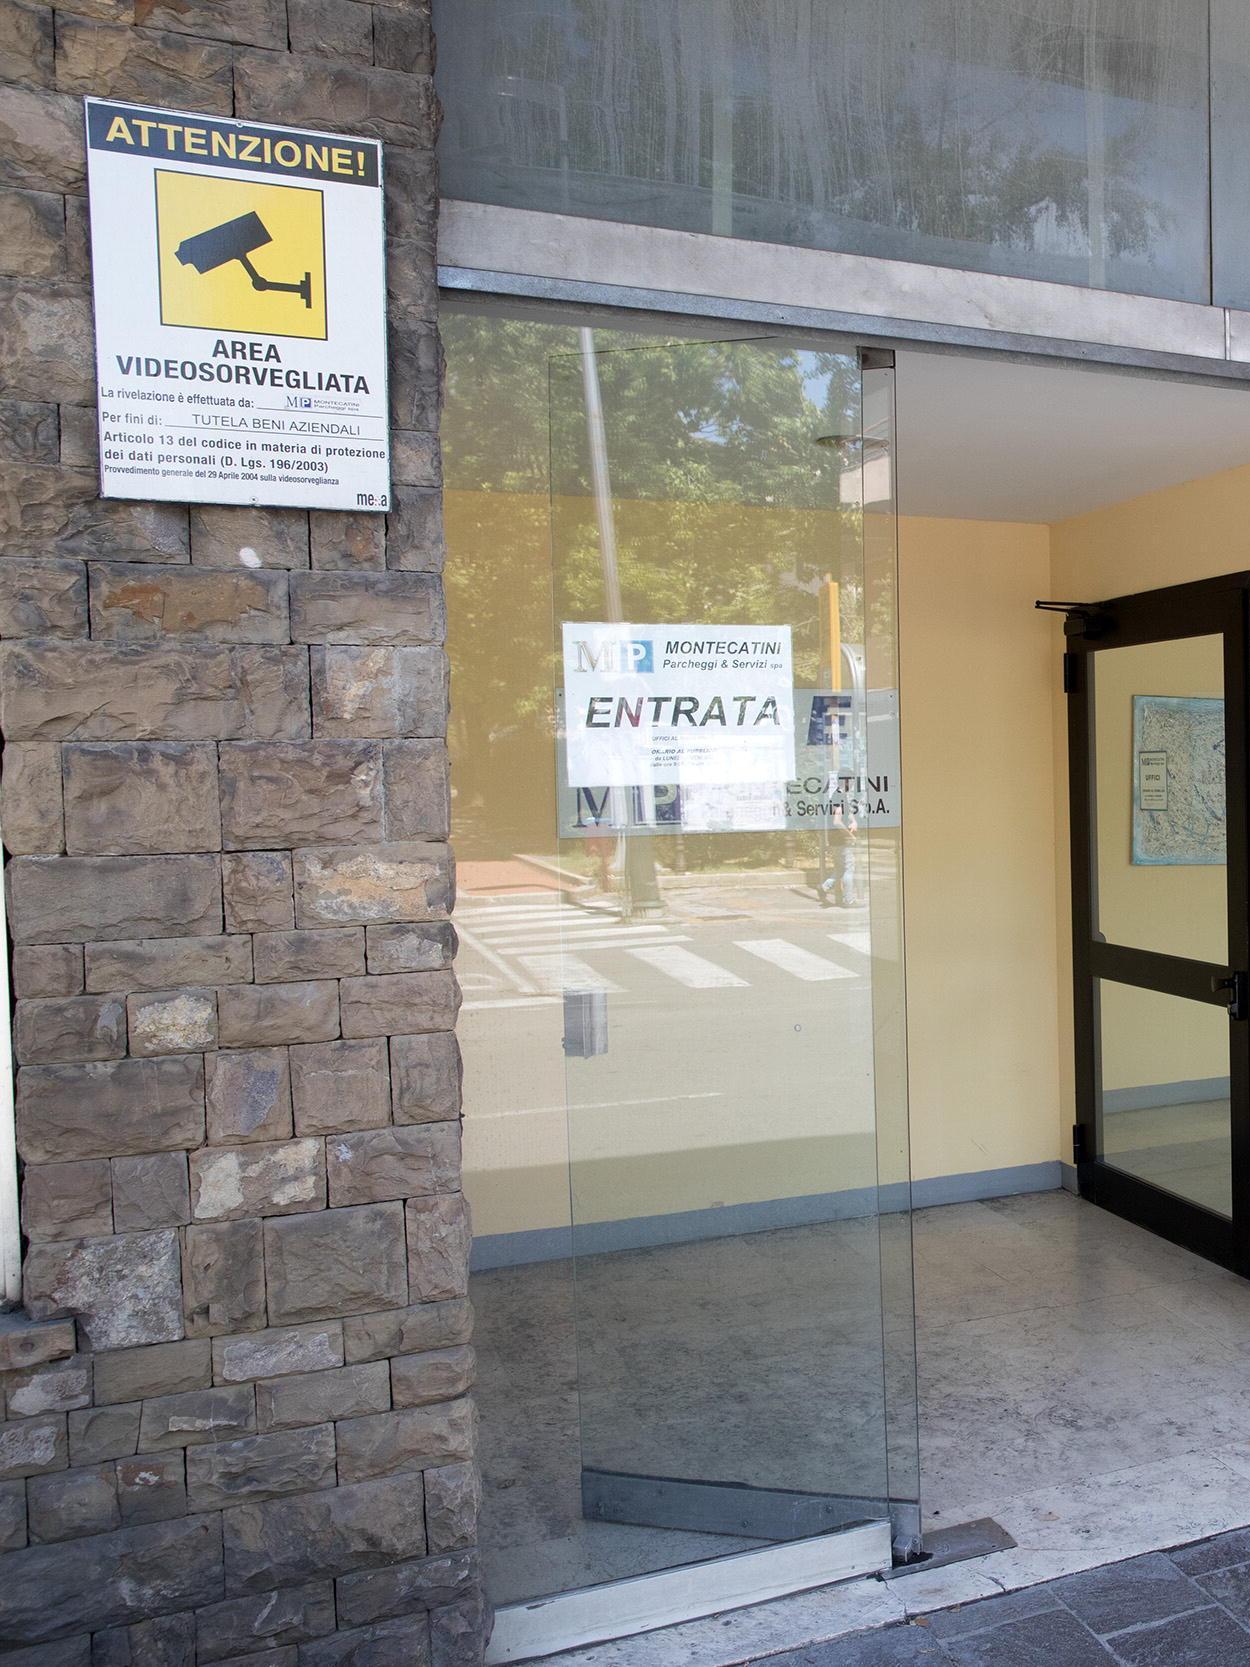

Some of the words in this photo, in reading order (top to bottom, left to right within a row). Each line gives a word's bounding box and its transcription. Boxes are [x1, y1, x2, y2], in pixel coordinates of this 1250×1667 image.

[105, 115, 366, 178] ATTENZIONE!
[212, 339, 282, 364] AREA
[116, 355, 371, 395] VIDEOSORVEGLIATA
[101, 387, 114, 398] La
[117, 388, 175, 403] rivelazione
[178, 392, 185, 403] è
[187, 394, 236, 407] effettuata
[238, 397, 255, 408] da:
[102, 411, 121, 423] Per
[125, 412, 144, 424] fini
[147, 415, 163, 426] di:
[191, 413, 249, 428] TUTELA
[252, 417, 286, 431] BENI
[289, 421, 361, 436] AZIENDALI
[103, 431, 154, 445] Articolo
[159, 435, 174, 446] 13
[178, 435, 197, 447] del
[201, 438, 242, 450] codice
[246, 440, 257, 451] in
[261, 442, 307, 454] materia
[311, 444, 322, 455] di
[326, 446, 386, 459] protezione
[104, 449, 124, 460] dei
[128, 450, 153, 462] dati
[157, 452, 216, 466] personali
[220, 456, 237, 468] (D.
[241, 457, 266, 470] Lgs.
[270, 459, 329, 474] 196/2003)
[104, 465, 160, 476] Provvedimento
[161, 469, 193, 478] generale
[195, 469, 206, 478] del
[218, 472, 240, 481] Aprile
[240, 472, 258, 481] 2004
[260, 473, 277, 482] sulla
[279, 474, 340, 487] videosorveglianza
[665, 640, 782, 656] MONTECATINI
[662, 659, 718, 671] Parcheggi
[720, 659, 730, 669] &
[731, 658, 768, 669] Servizi
[585, 695, 781, 729] ENTRATA
[796, 800, 846, 818] Servizi
